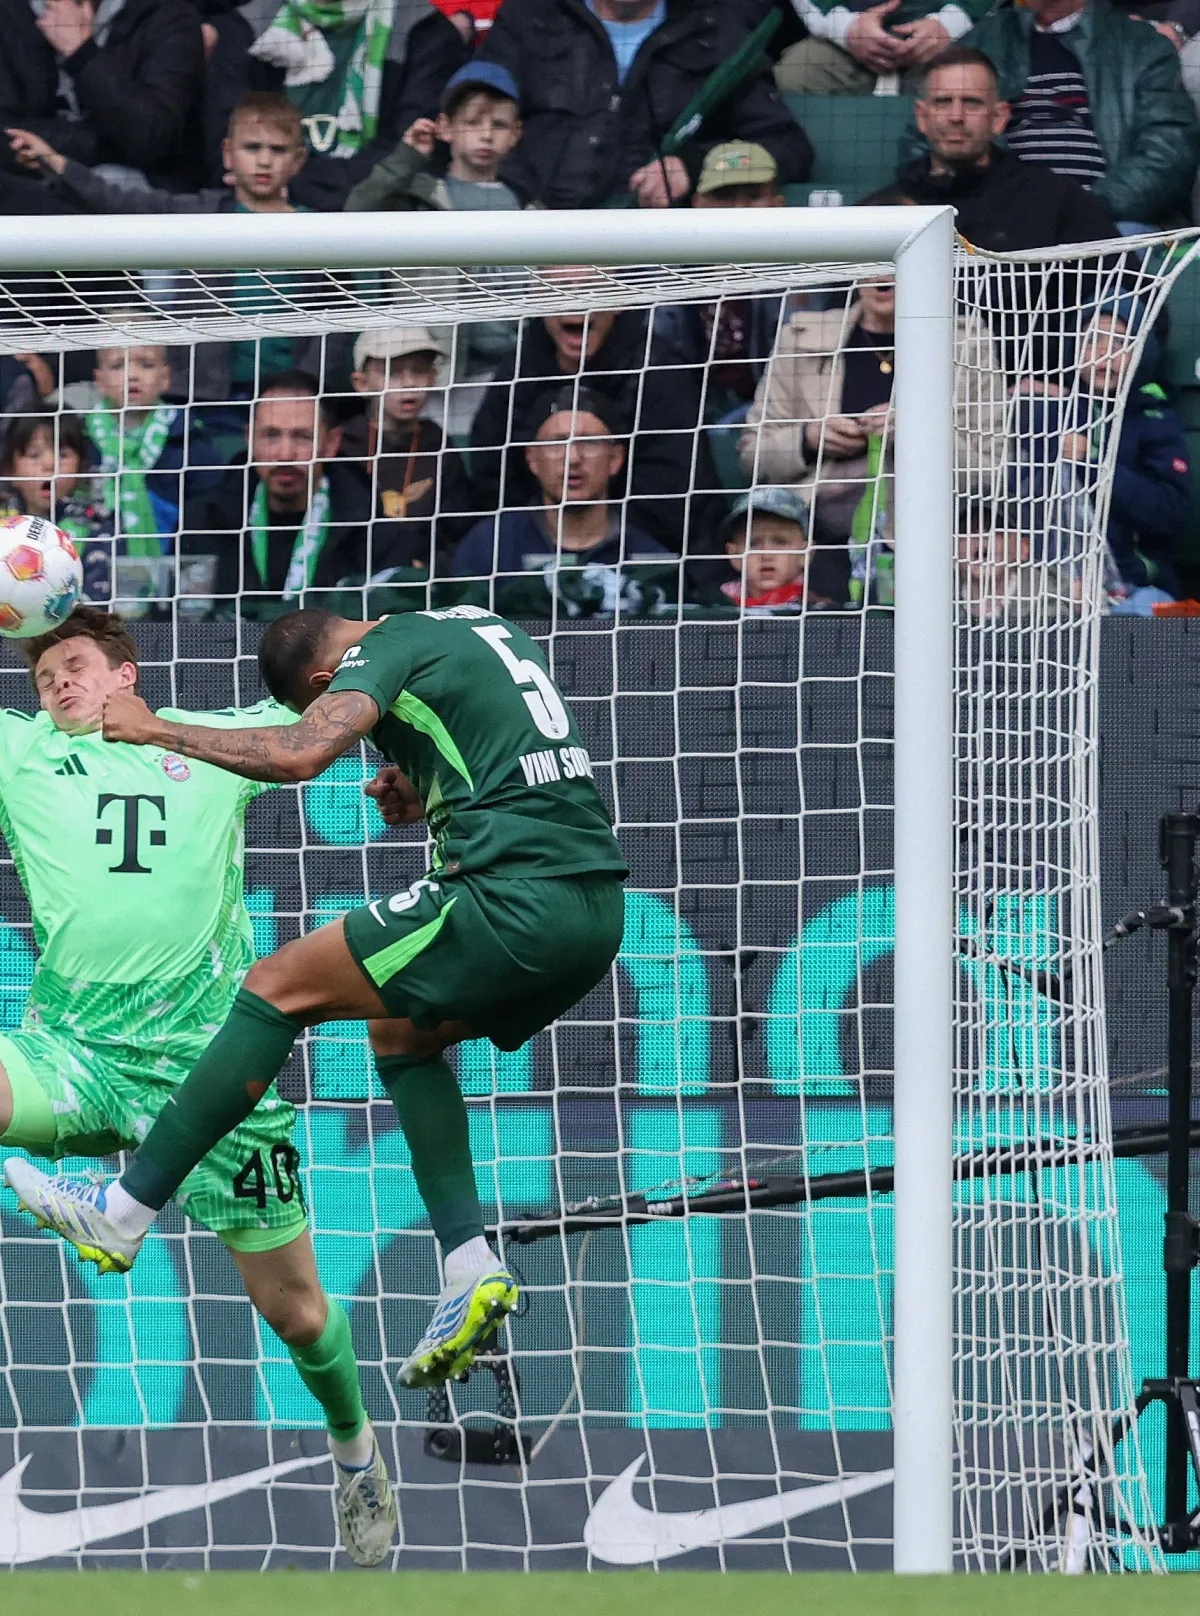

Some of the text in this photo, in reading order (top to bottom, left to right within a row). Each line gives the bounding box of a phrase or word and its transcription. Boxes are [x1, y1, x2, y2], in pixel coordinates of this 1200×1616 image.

[471, 624, 570, 740] 5
[518, 747, 561, 788] VINI
[231, 1143, 301, 1210] 40
